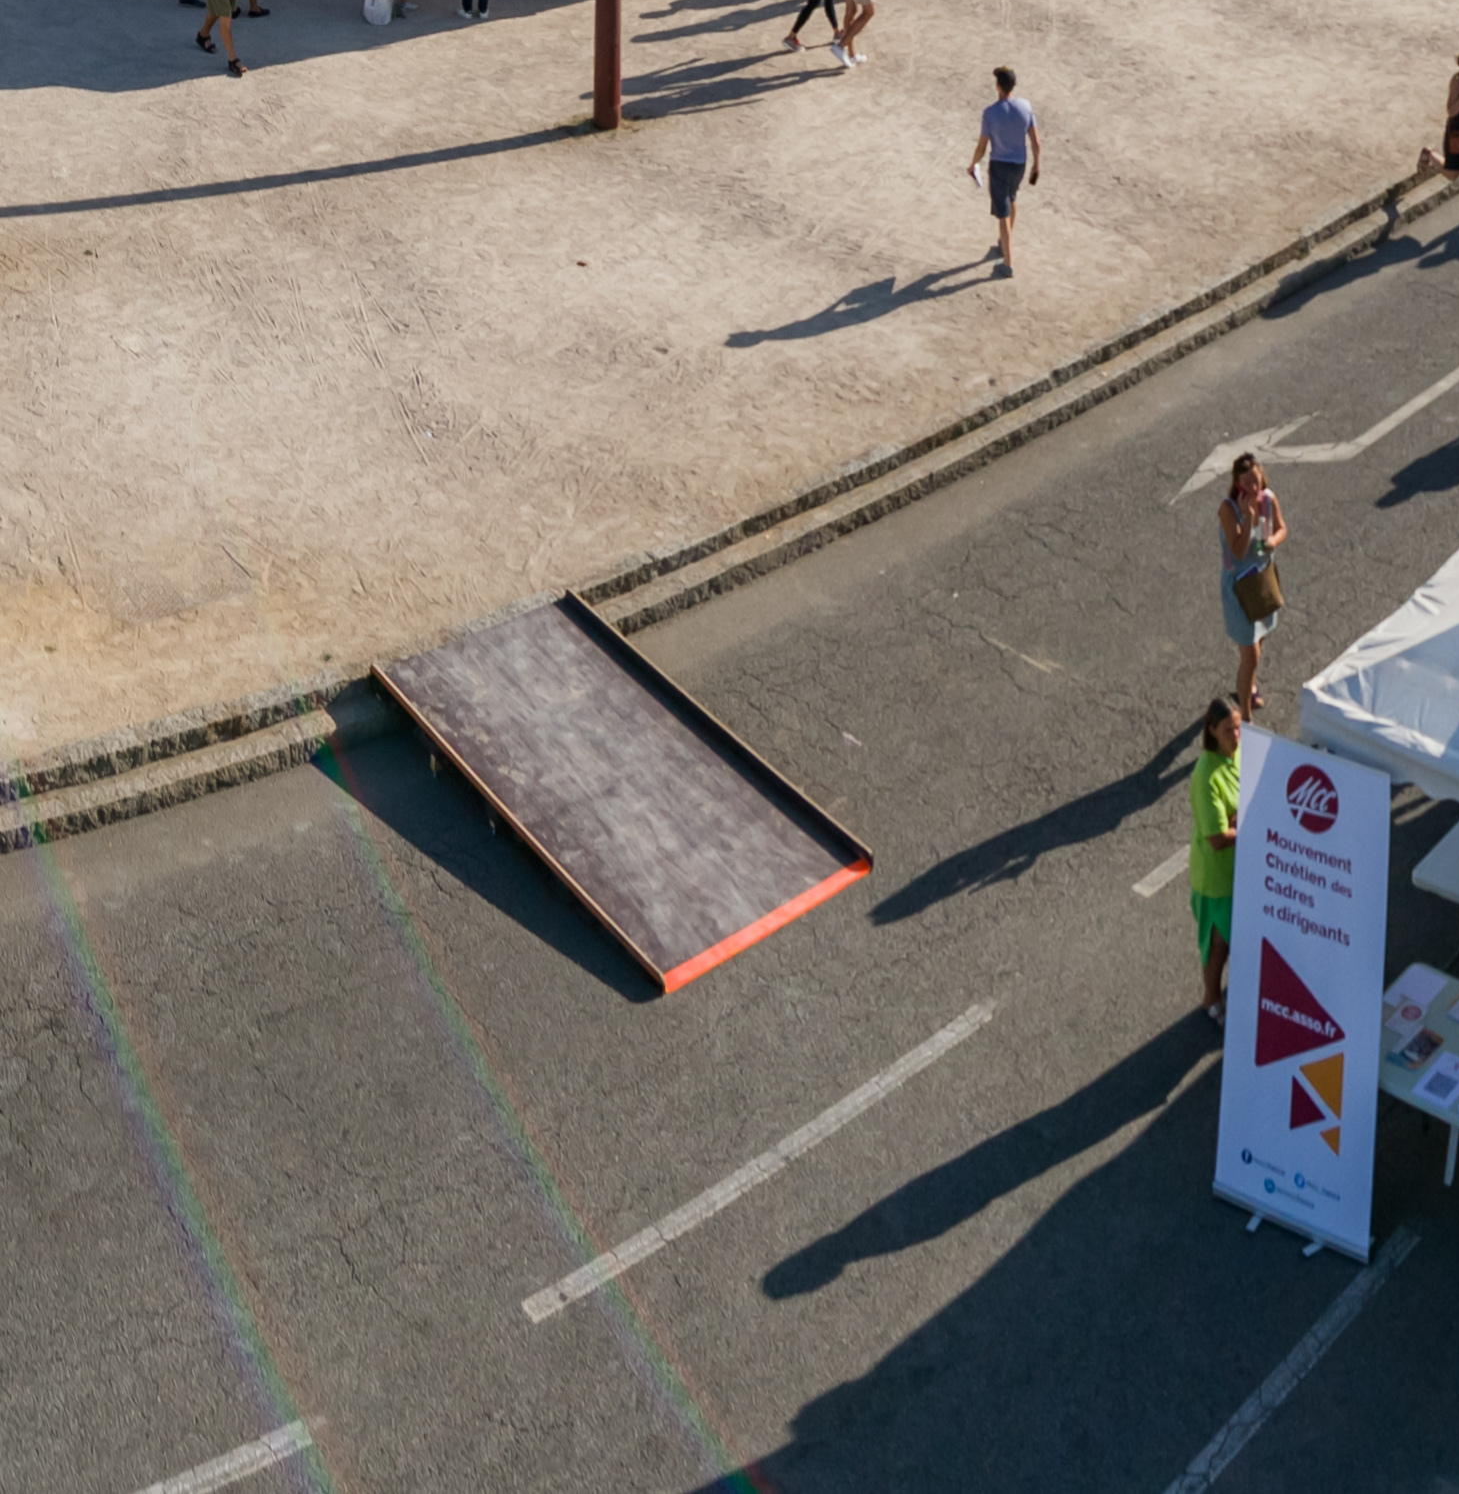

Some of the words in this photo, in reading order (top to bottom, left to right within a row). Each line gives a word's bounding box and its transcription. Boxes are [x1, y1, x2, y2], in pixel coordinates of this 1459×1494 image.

[1266, 828, 1352, 874] Mouvement
[1264, 875, 1315, 908] Cadres
[1265, 853, 1327, 889] Chrétien
[1331, 880, 1352, 898] des
[1263, 905, 1275, 917] et
[1277, 904, 1350, 947] dirigeants
[1261, 997, 1336, 1039] mcc.asso.fr
